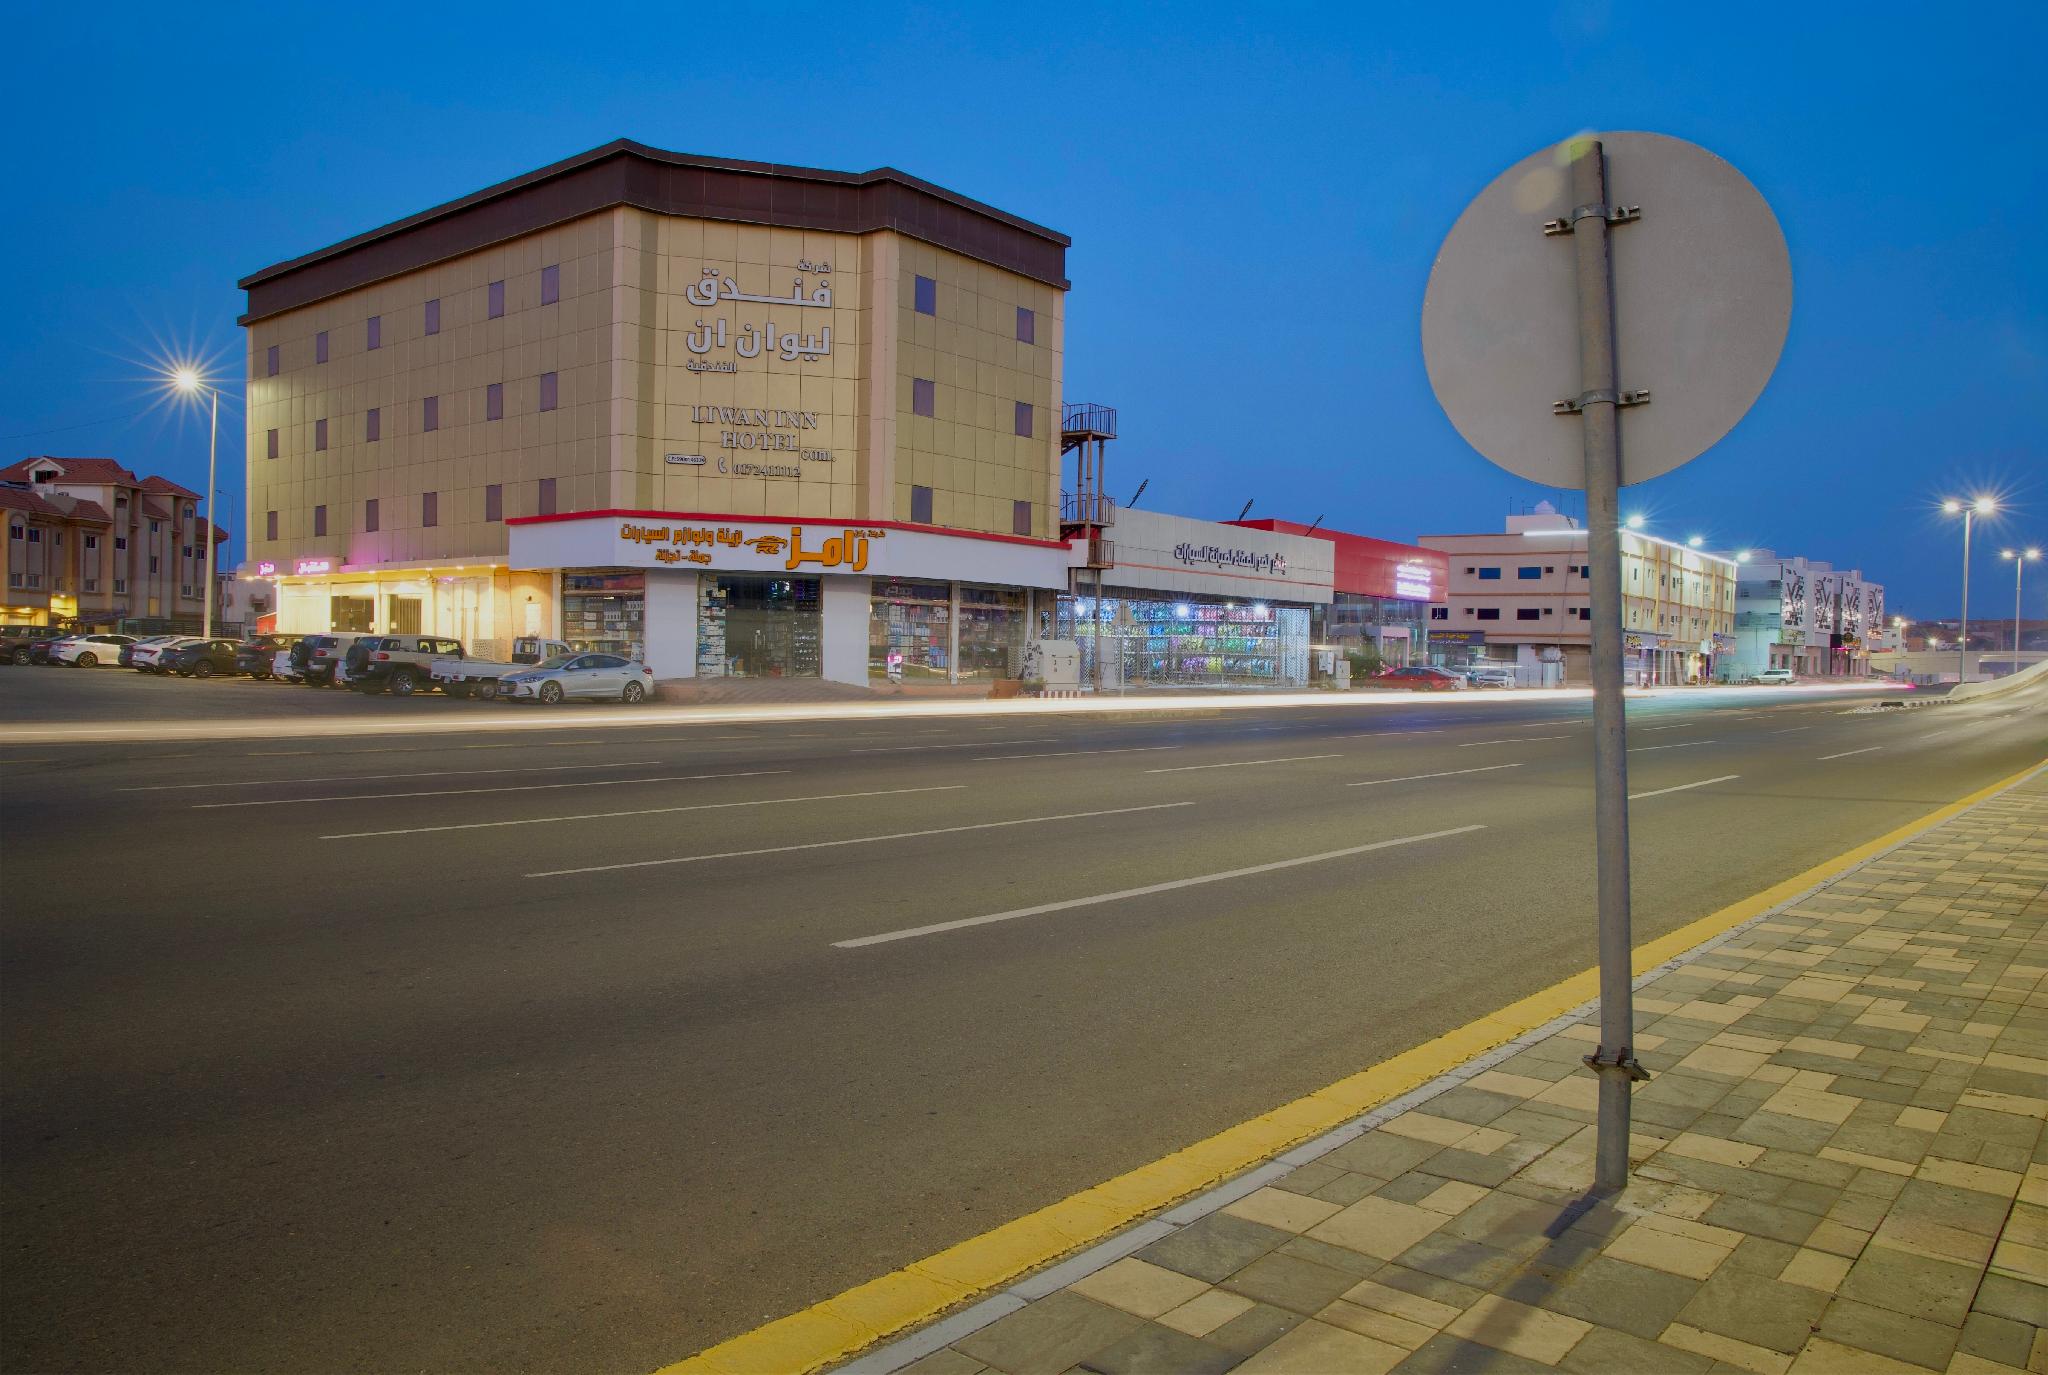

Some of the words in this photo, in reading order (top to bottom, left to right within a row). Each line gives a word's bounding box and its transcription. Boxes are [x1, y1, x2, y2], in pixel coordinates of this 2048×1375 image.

[686, 268, 832, 308] فندق
[686, 318, 727, 354] ان
[736, 322, 831, 362] ليوان
[691, 405, 770, 428] LIWAN
[775, 410, 820, 430] INN
[720, 431, 799, 452] HOTEL
[620, 523, 670, 544] السيارات
[673, 526, 714, 547] ولوازم
[688, 549, 712, 565] جملة
[785, 526, 869, 572] رامز
